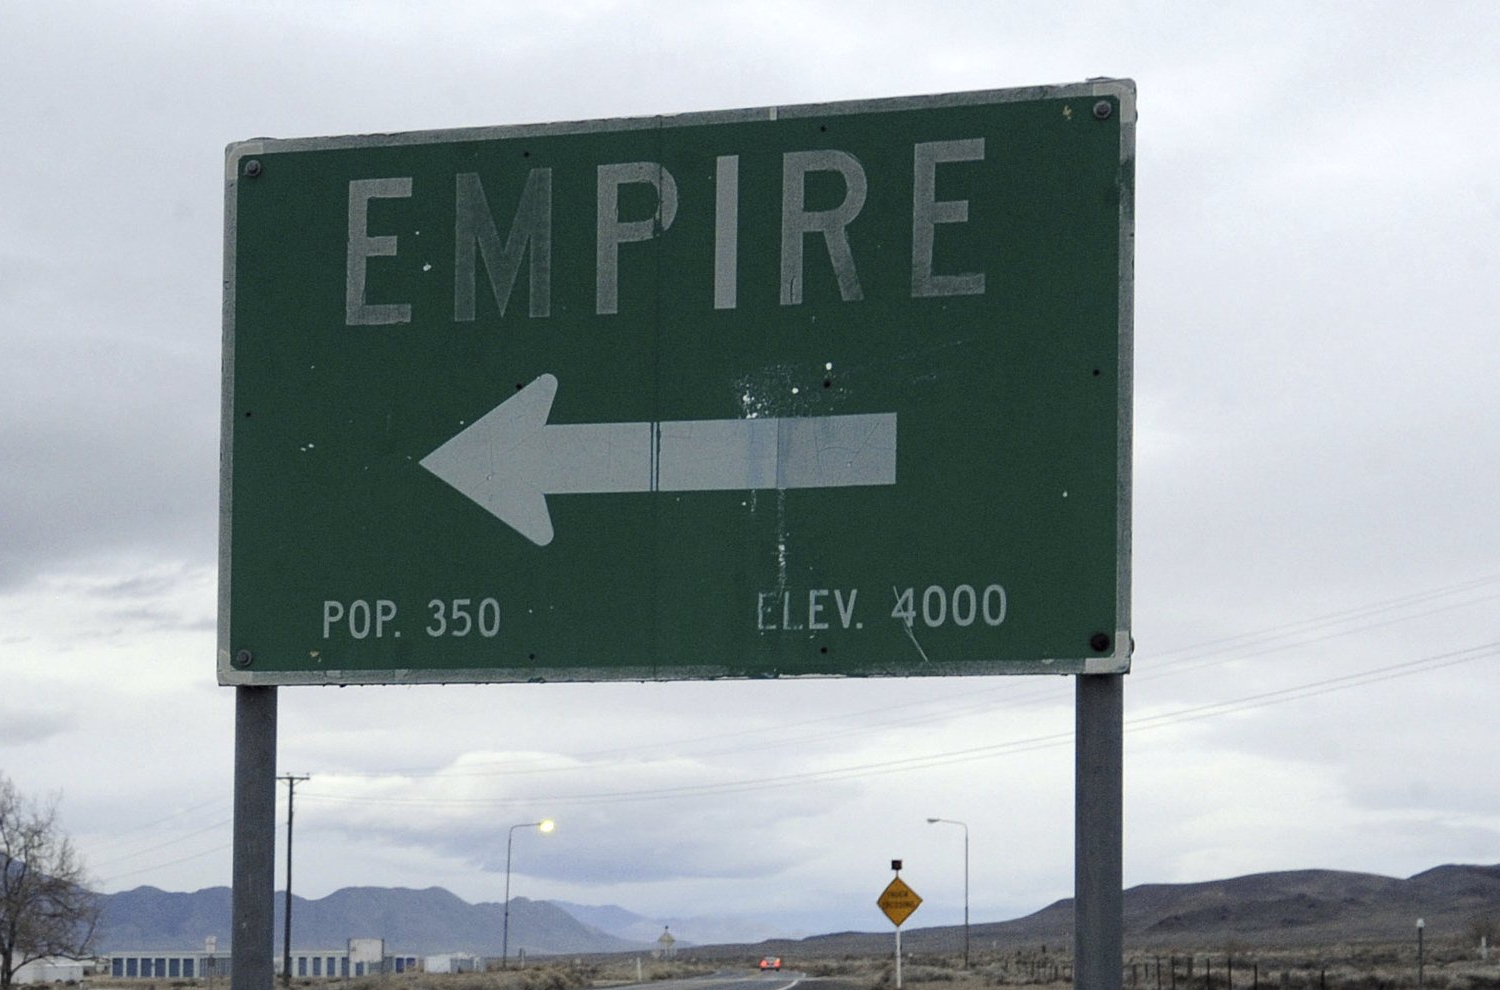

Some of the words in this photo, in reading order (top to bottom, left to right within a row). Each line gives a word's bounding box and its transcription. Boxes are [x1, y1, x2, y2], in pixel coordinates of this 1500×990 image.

[345, 137, 987, 326] EMPIRE
[323, 599, 401, 639] POP.
[426, 597, 501, 638] 350
[757, 588, 864, 631] ELEV.
[891, 584, 1007, 628] 4000
